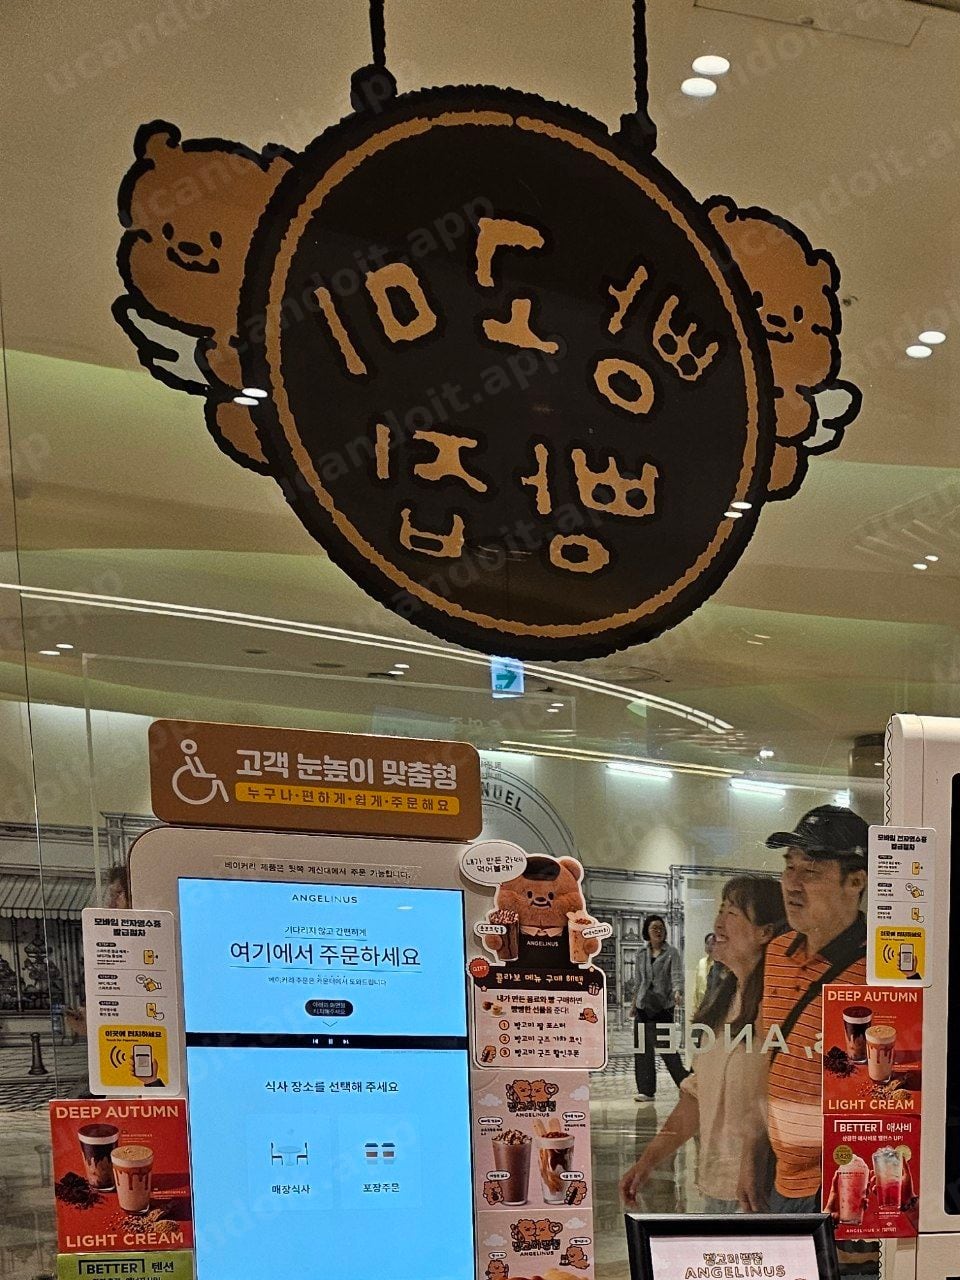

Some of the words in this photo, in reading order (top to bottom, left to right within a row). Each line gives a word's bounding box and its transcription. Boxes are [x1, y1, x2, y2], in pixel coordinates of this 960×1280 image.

[236, 749, 289, 779] 고객
[297, 753, 374, 784] 눈높이
[382, 758, 458, 789] 맞춤형
[292, 894, 358, 904] ANGELINUS
[230, 942, 313, 965] 여기에서
[320, 946, 420, 967] 주문하세요
[828, 991, 861, 1001] DEEP
[865, 992, 918, 1002] AUTUMN
[265, 1081, 288, 1092] 식사
[291, 1082, 325, 1093] 장소를
[329, 1081, 362, 1092] 선택해
[366, 1081, 399, 1092] 주세요
[829, 1100, 866, 1110] LIGHT
[870, 1100, 914, 1110] CREAM
[56, 1107, 101, 1118] DEEP
[106, 1105, 179, 1118] AUTUMN
[839, 1124, 877, 1132] BETTER
[887, 1123, 912, 1132] 애사비
[271, 1184, 310, 1194] 매장식사
[363, 1183, 400, 1193] 포장주문
[66, 1234, 117, 1247] LIGHT
[124, 1231, 184, 1245] CREAM
[86, 1264, 137, 1274] BETTER
[152, 1261, 174, 1273] 텐션
[685, 1265, 786, 1279] ANGELINUS
